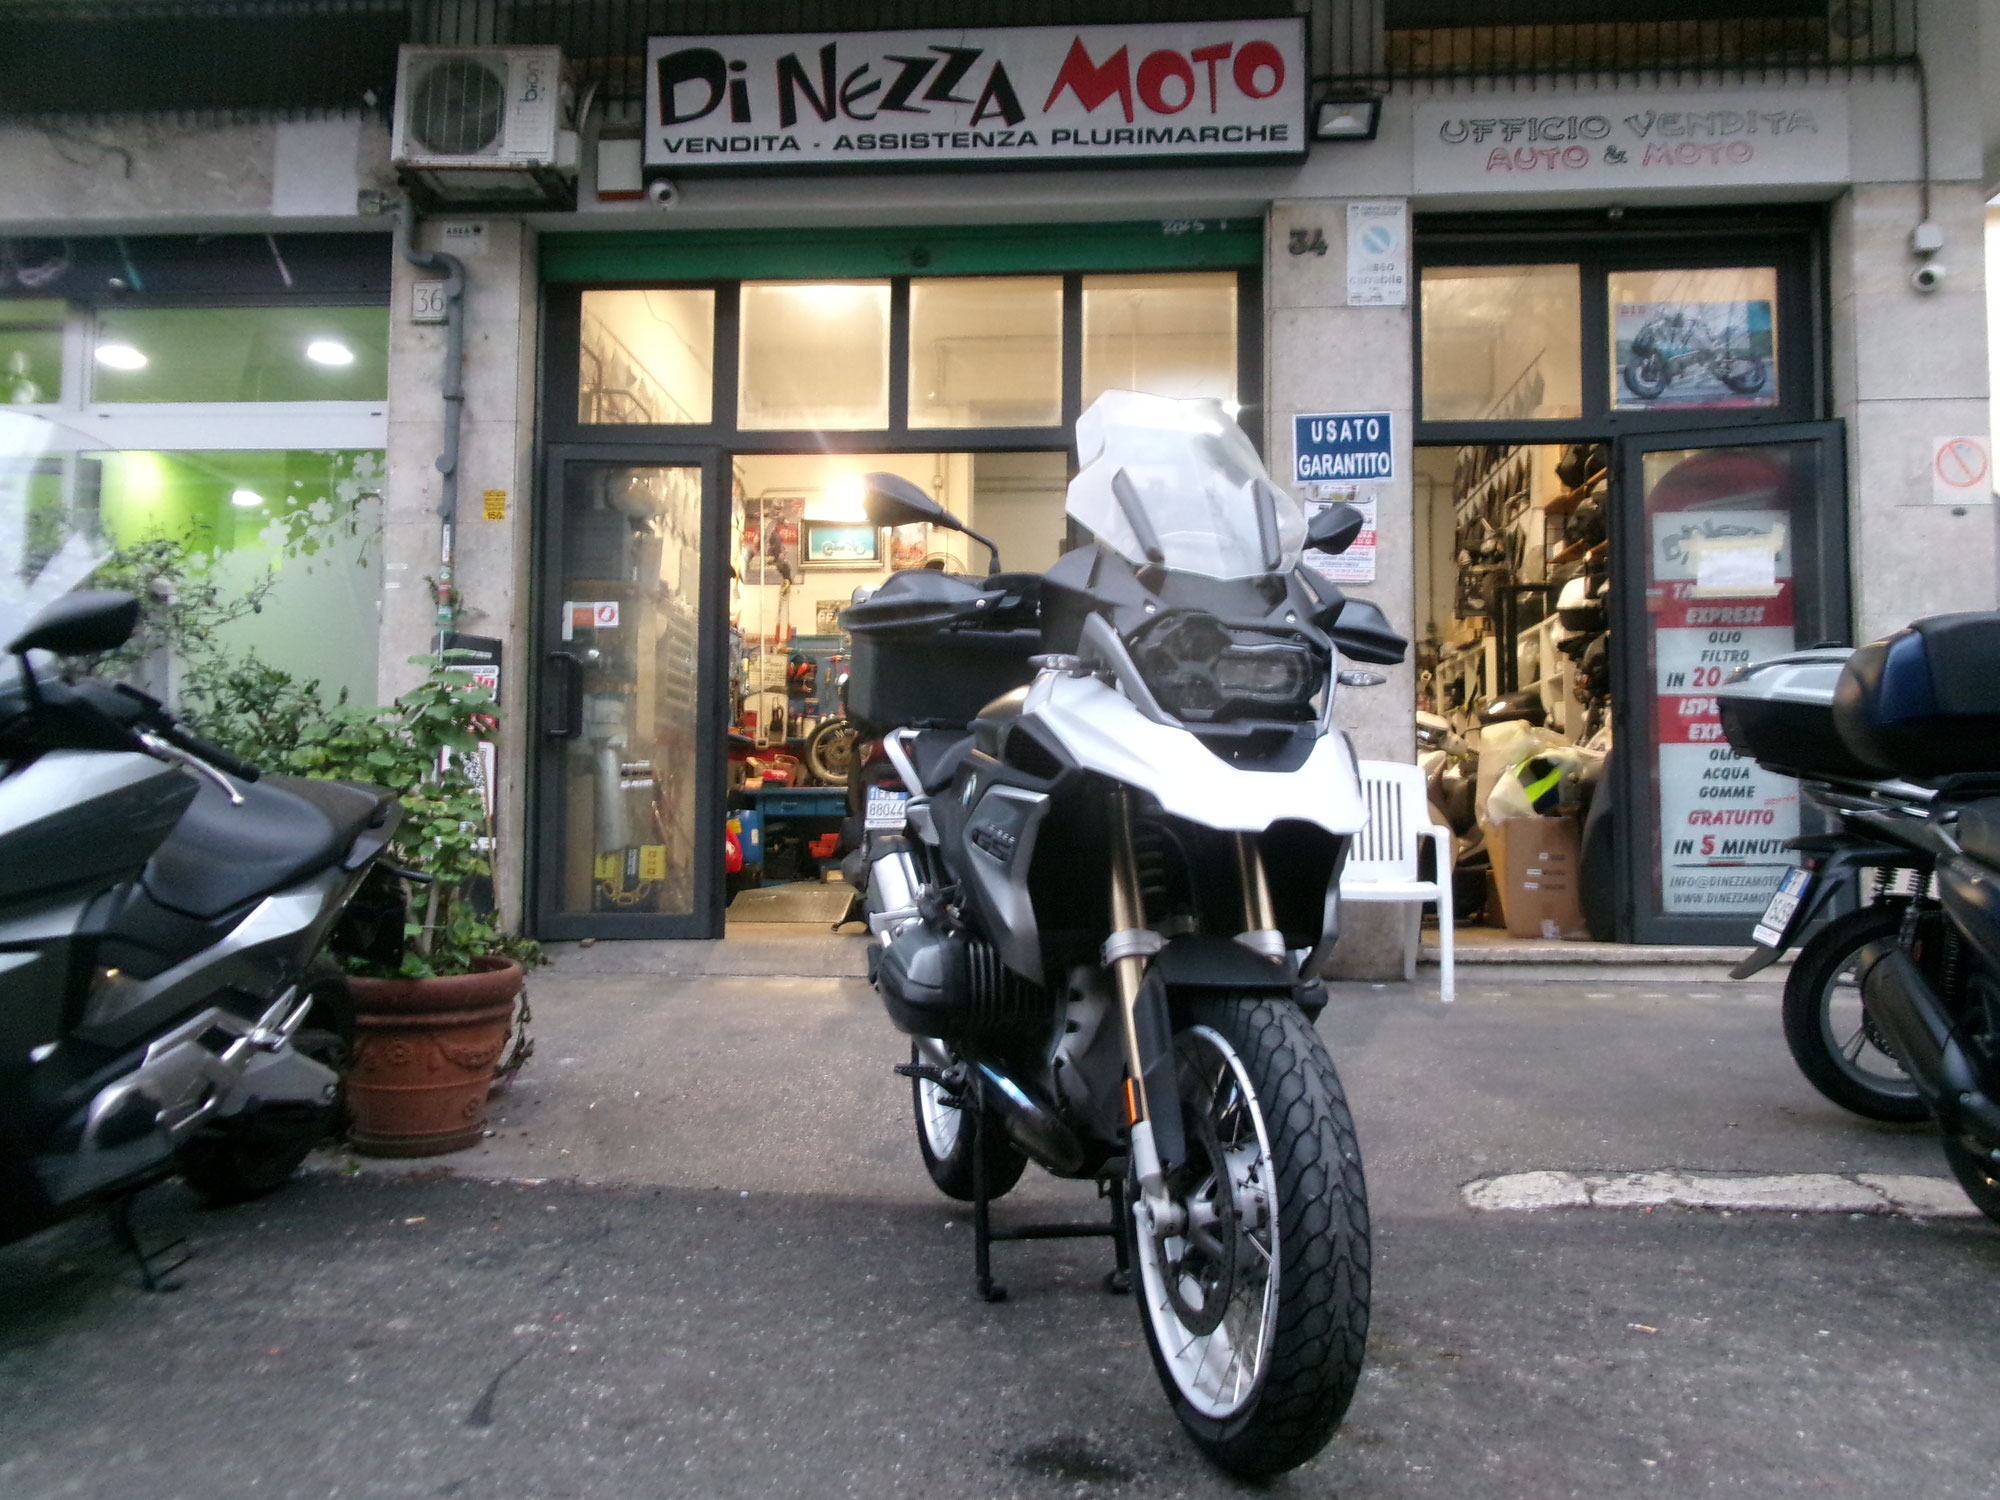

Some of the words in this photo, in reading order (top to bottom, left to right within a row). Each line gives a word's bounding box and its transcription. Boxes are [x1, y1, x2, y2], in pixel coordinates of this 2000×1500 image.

[657, 46, 751, 126] Di
[1042, 35, 1285, 124] MOTO
[1439, 114, 1611, 144] UFFICIO
[1623, 109, 1819, 140] VENDITA
[663, 134, 800, 154] VENDITA
[833, 129, 1038, 152] ASSISTENZA
[1051, 124, 1288, 146] PLURIMARCHE
[1486, 144, 1589, 172] AUTO
[1603, 145, 1629, 165] &
[1642, 139, 1755, 168] MOTO
[1289, 228, 1328, 256] 34
[415, 287, 444, 314] 36
[1311, 418, 1379, 443] USATO
[1299, 452, 1390, 478] GARANTITO
[1685, 606, 1765, 625] EXPRESS
[1708, 631, 1741, 643] OLIO
[1700, 650, 1749, 662] FILTRO
[1666, 673, 1685, 688] IN
[1692, 666, 1721, 687] 20
[1703, 767, 1750, 780] ACQUA
[1699, 786, 1755, 798] GOMME
[869, 802, 904, 818] 88044
[1688, 810, 1775, 826] GRATUITO
[1673, 839, 1694, 855] IN
[1701, 835, 1716, 855] 5
